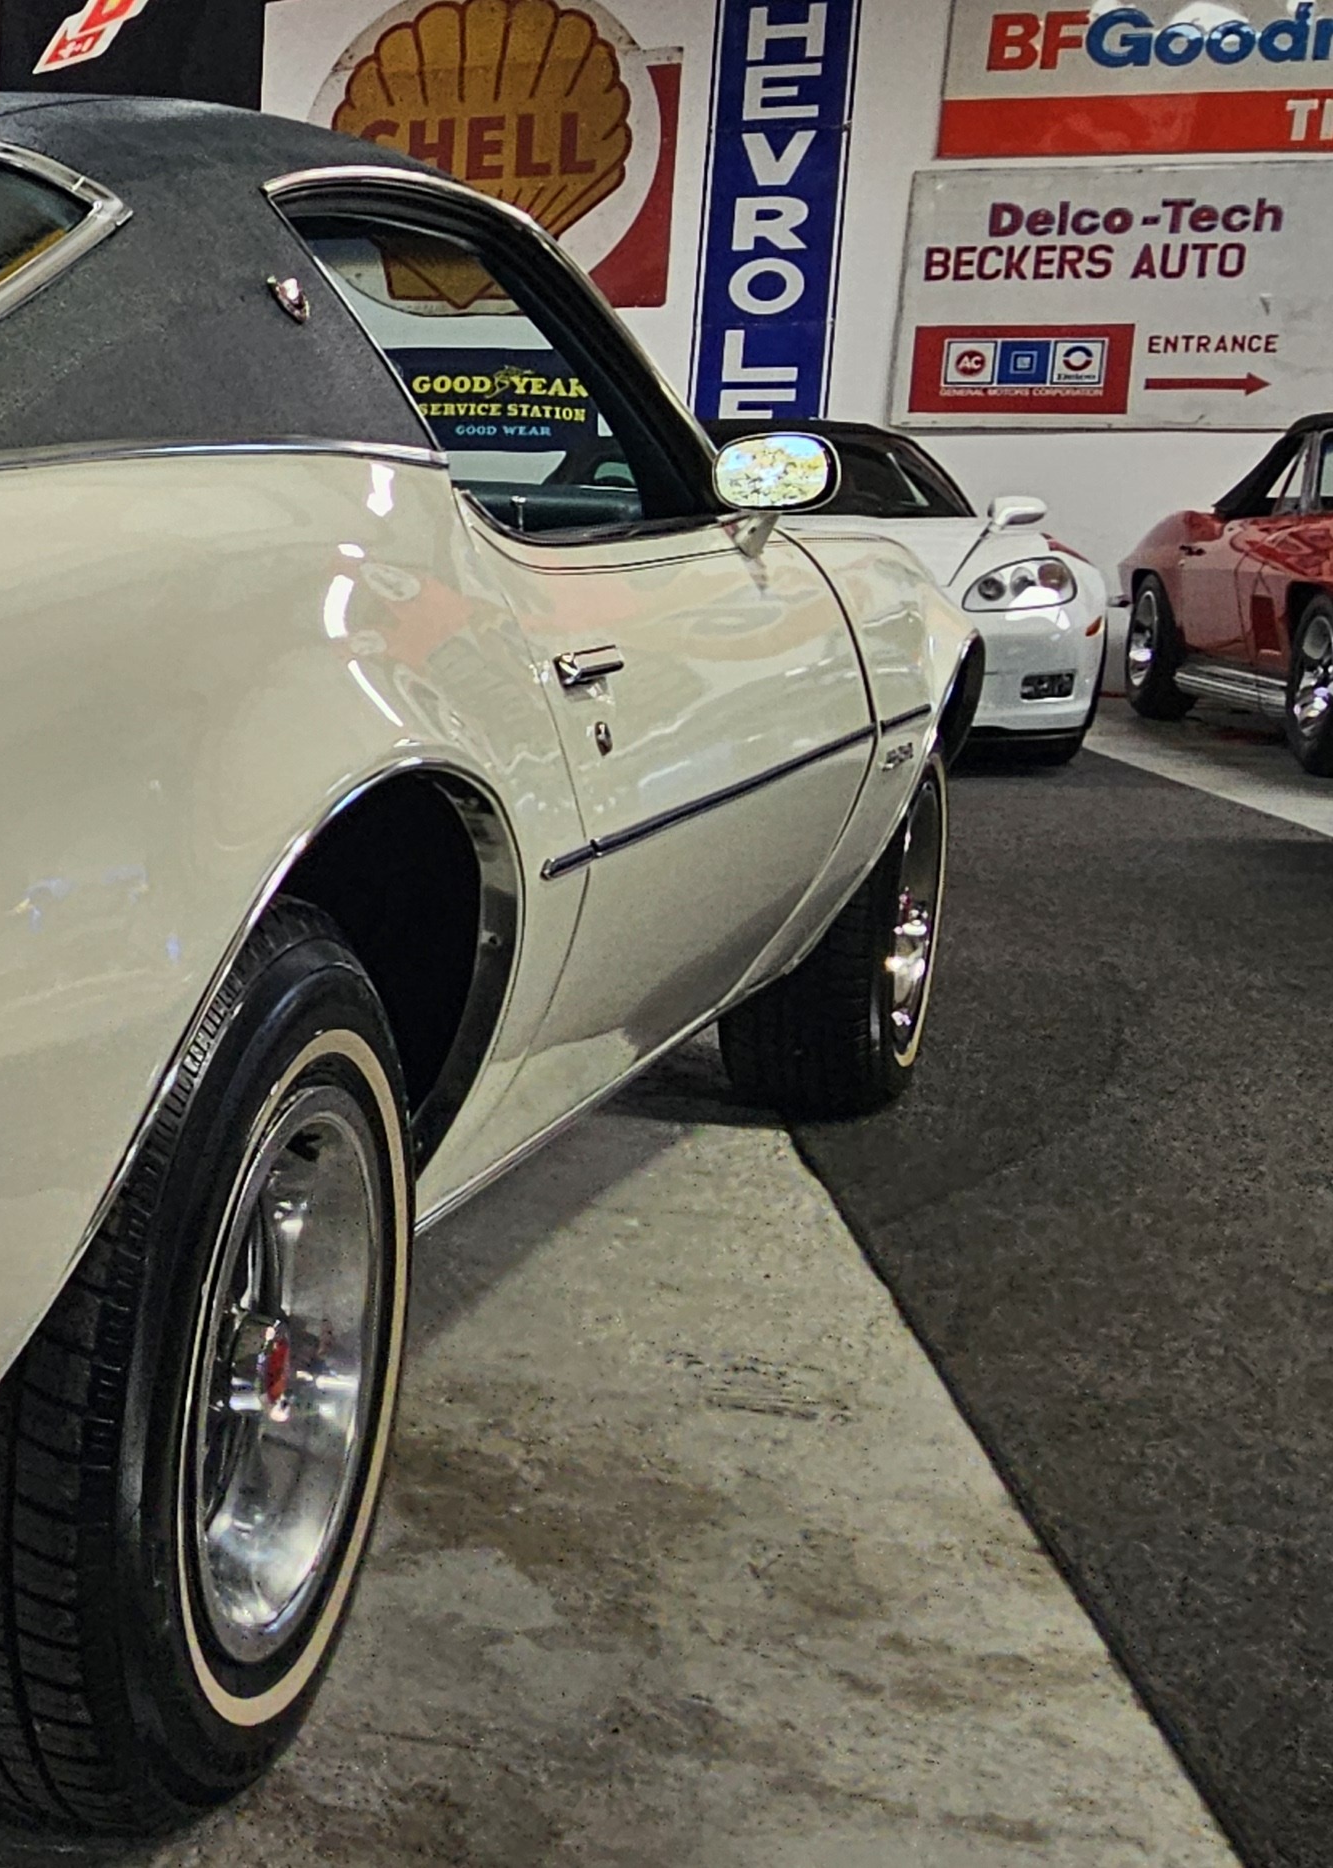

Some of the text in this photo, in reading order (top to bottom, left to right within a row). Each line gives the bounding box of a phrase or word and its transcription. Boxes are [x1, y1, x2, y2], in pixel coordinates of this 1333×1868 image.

[988, 198, 1283, 238] Delco-Tech
[923, 242, 1248, 282] BECKERS AUTO
[1146, 334, 1280, 355] ENTRANCE
[957, 355, 983, 370] AC
[416, 402, 586, 421] SERVICE STATION
[454, 424, 552, 437] GOOD WEAR
